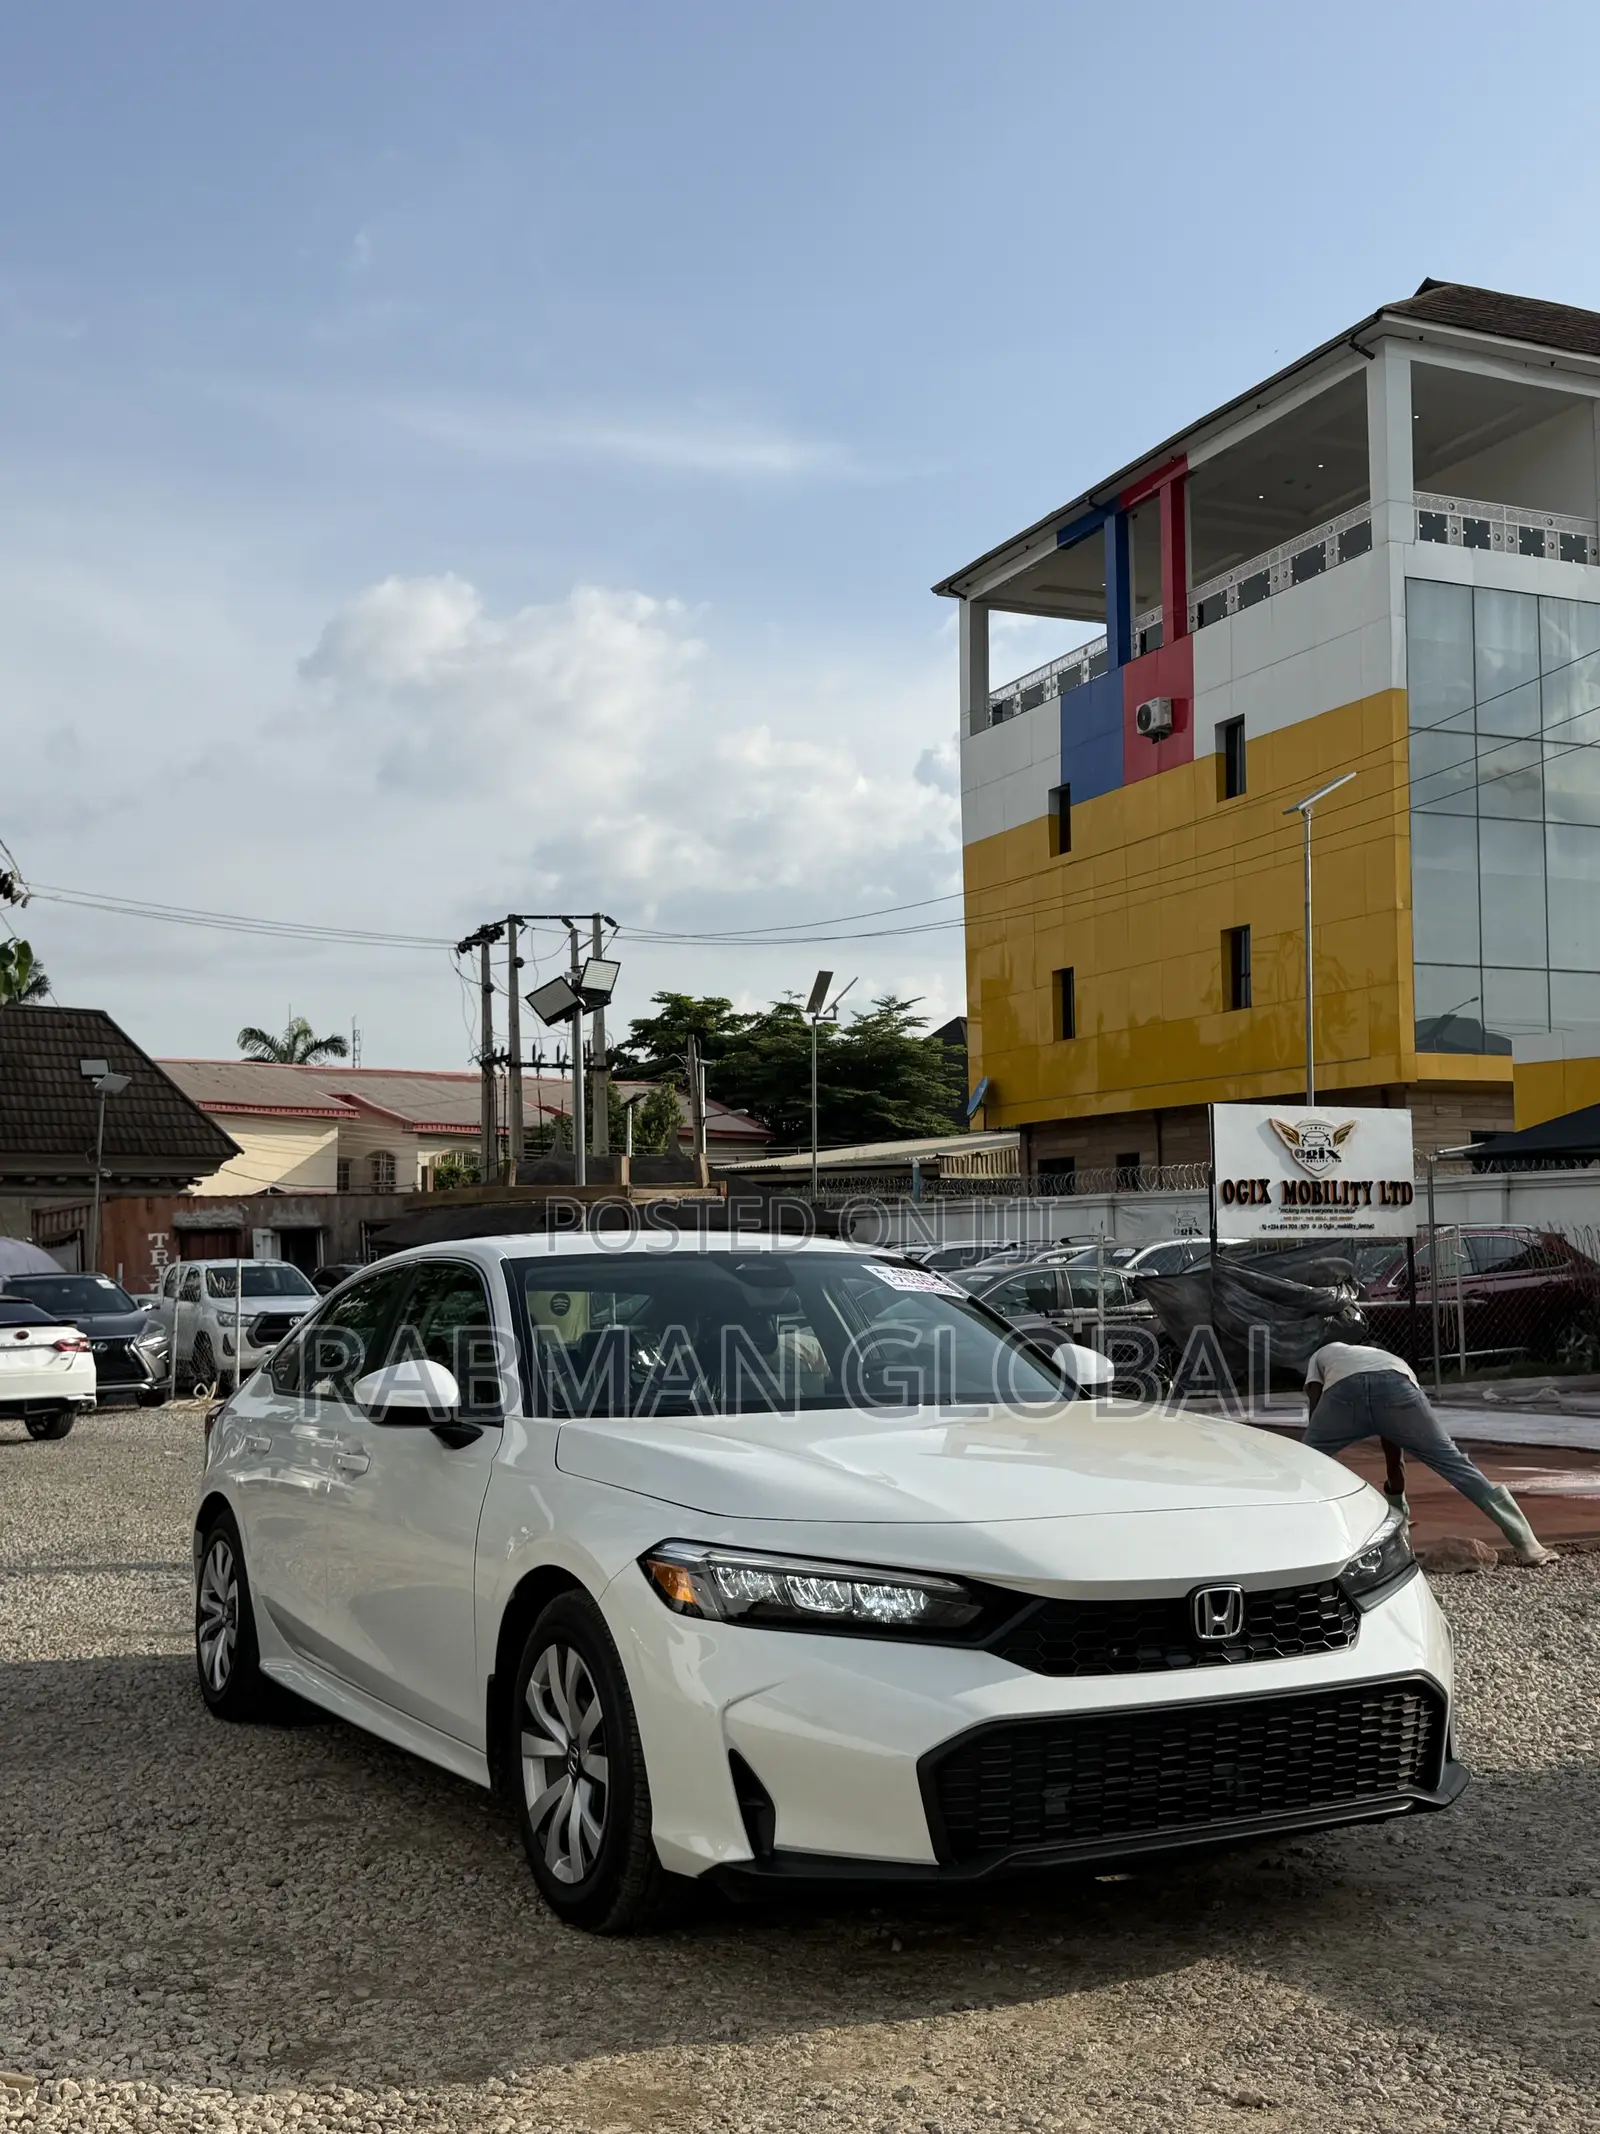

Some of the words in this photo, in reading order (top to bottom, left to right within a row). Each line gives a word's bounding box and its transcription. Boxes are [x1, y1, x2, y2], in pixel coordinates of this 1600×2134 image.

[1222, 1179, 1272, 1205] OGIX
[1282, 1180, 1373, 1205] MOBILITY
[1379, 1180, 1413, 1206] LTD
